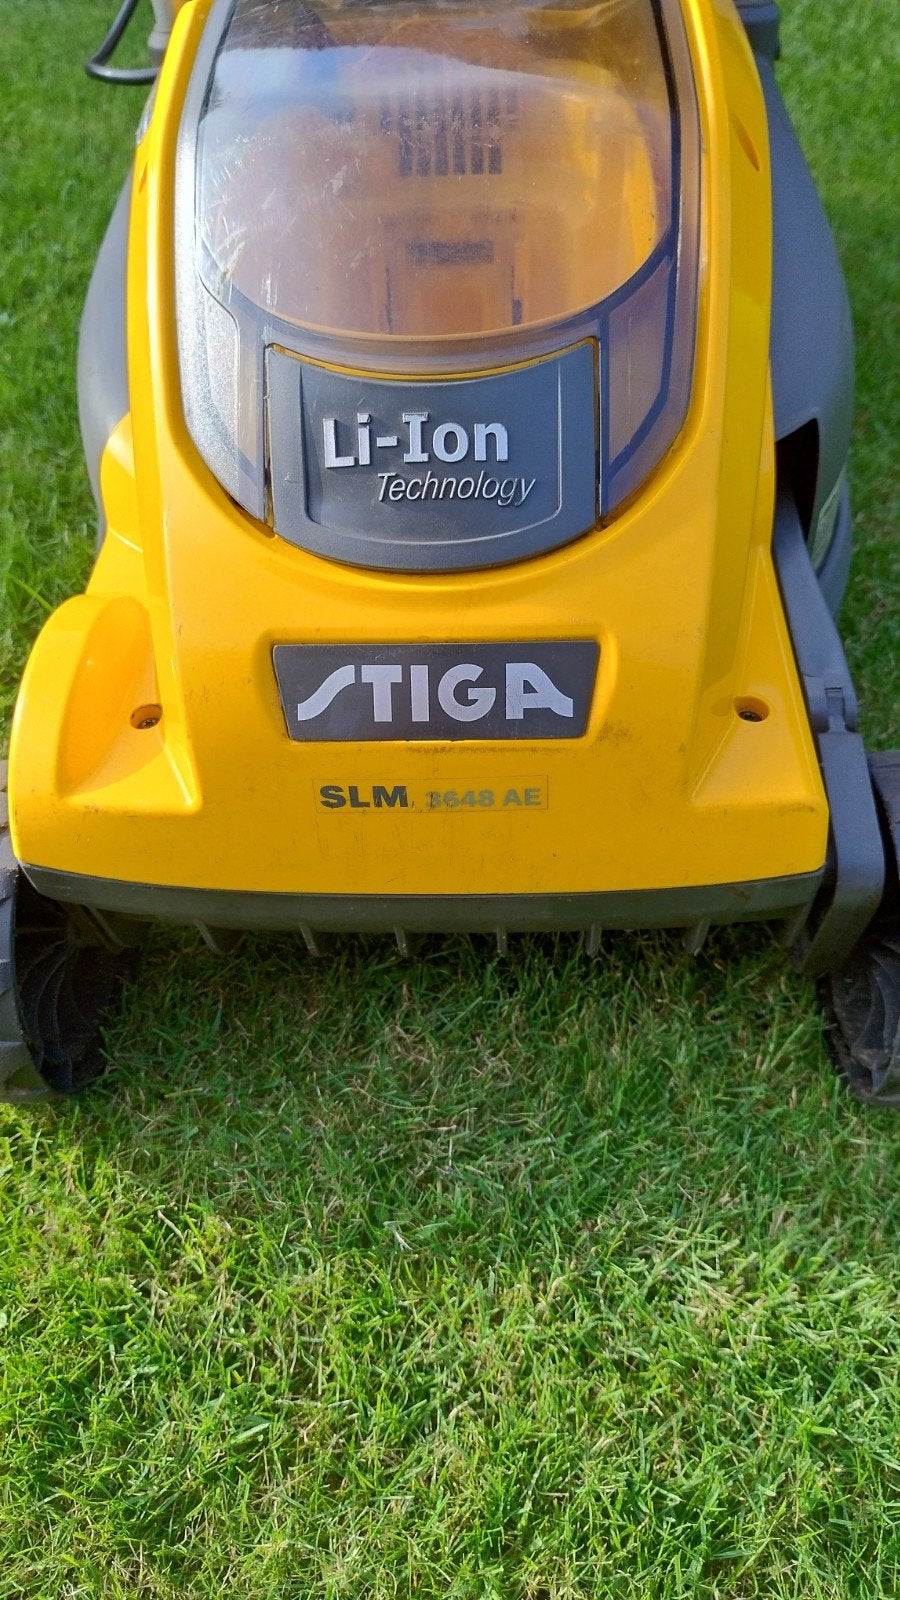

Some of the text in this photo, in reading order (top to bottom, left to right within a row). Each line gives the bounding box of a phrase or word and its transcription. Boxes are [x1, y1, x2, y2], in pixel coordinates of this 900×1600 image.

[322, 412, 509, 468] Li-Ion
[377, 470, 536, 506] Technology
[297, 662, 574, 722] STIGA
[319, 785, 541, 808] SLM 3648 AE
